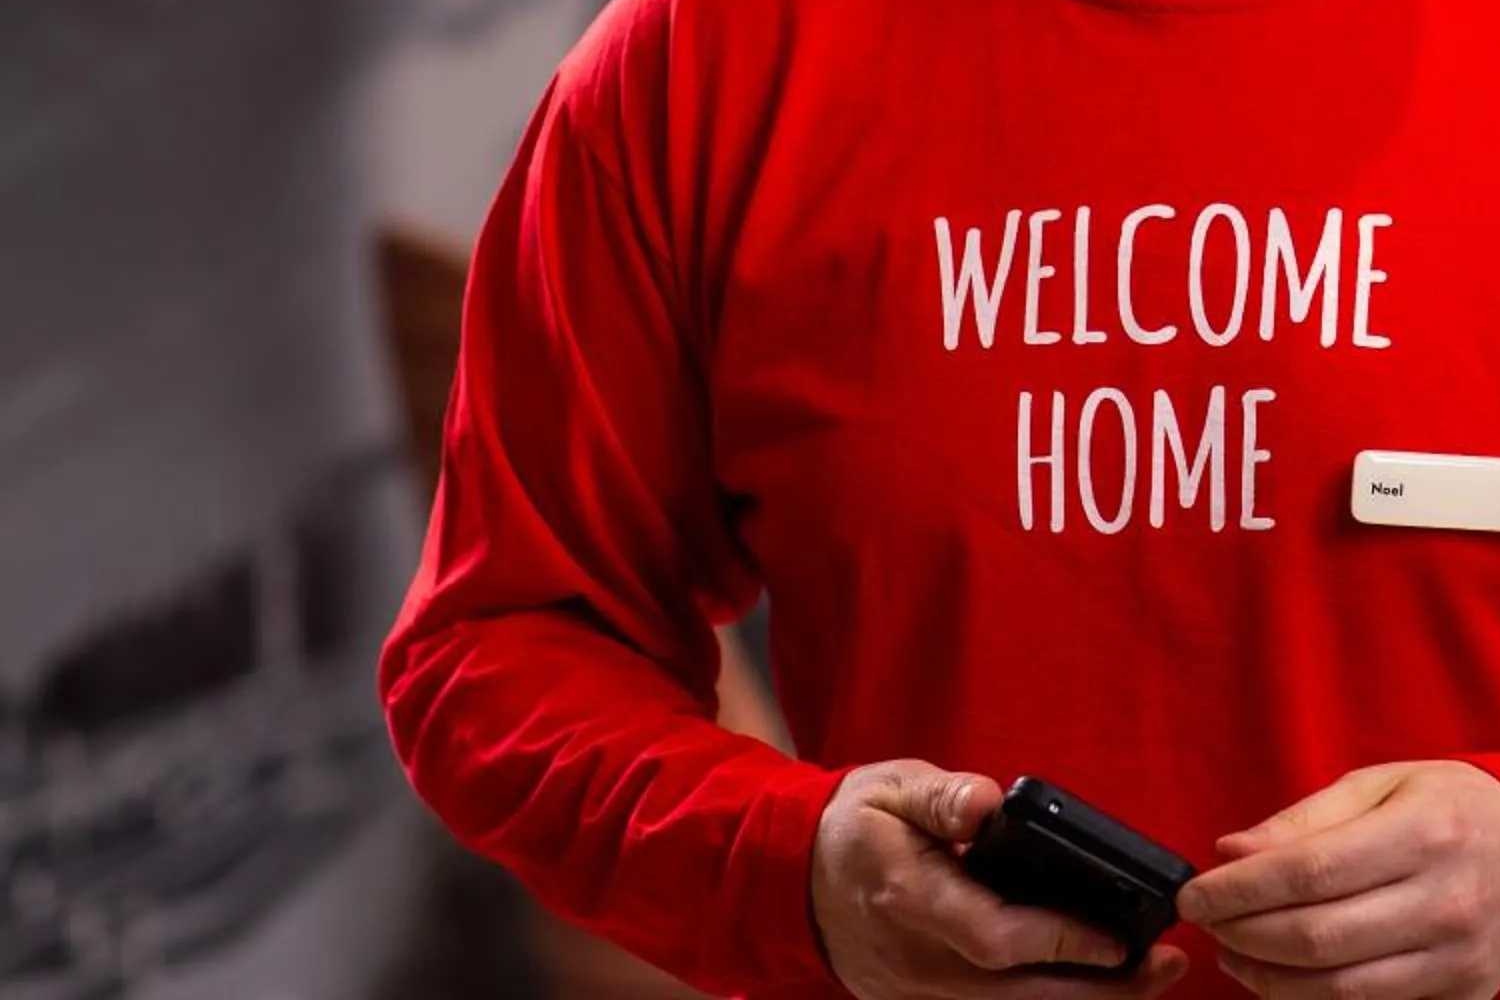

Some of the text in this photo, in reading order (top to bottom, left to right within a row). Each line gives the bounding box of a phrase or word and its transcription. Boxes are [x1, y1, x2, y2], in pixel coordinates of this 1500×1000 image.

[934, 203, 1393, 350] WELCOME
[1017, 385, 1276, 534] HOME
[1371, 483, 1403, 497] Noel
